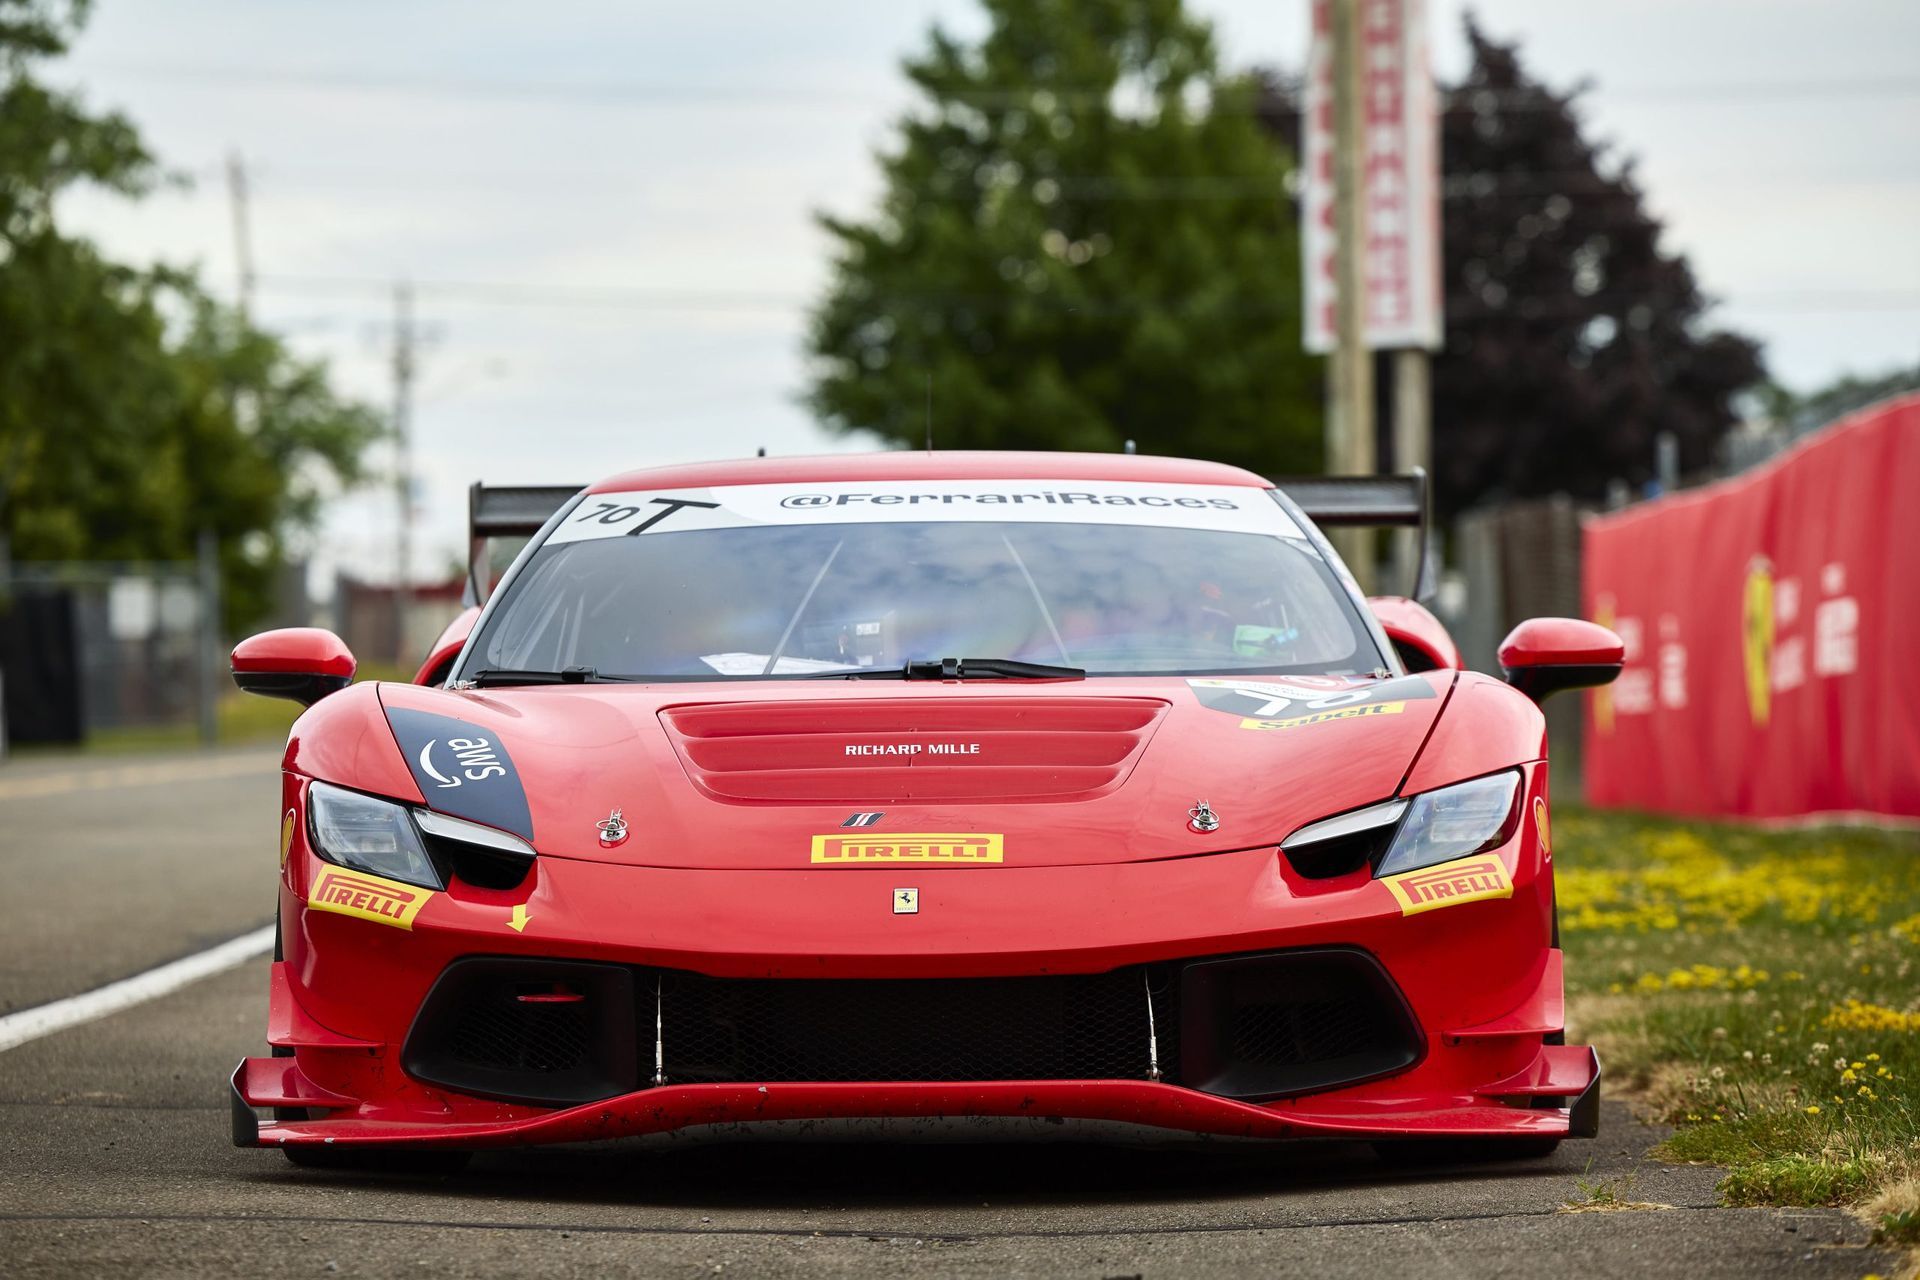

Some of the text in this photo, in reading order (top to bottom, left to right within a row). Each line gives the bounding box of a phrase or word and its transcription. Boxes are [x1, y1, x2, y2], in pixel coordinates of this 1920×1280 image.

[780, 491, 1240, 510] @FerrariRaces
[576, 498, 722, 536] 70 T
[1257, 704, 1388, 728] Sabelt
[448, 738, 506, 780] aws
[845, 743, 980, 756] RICHARD MILLE
[824, 837, 991, 858] PIRELLI
[315, 873, 416, 919] PIRELLI
[1397, 862, 1505, 905] PIRELLI
